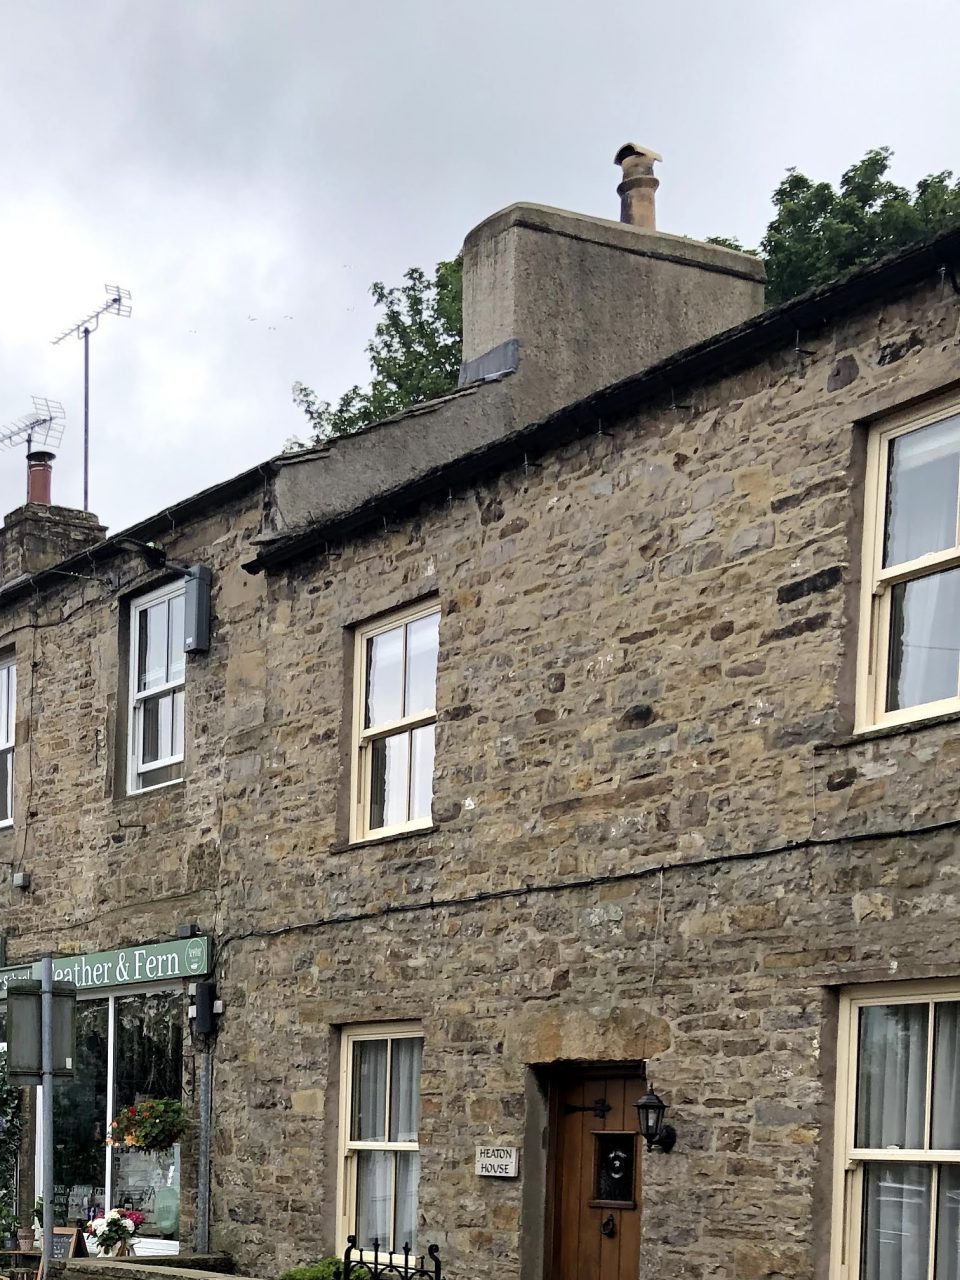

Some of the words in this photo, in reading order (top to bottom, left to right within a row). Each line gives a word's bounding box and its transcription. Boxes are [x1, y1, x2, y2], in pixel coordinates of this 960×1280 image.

[52, 957, 112, 987] eather
[116, 952, 130, 982] &
[134, 950, 181, 980] Fern
[480, 1148, 512, 1159] HEATON
[481, 1163, 510, 1174] HOUSE
